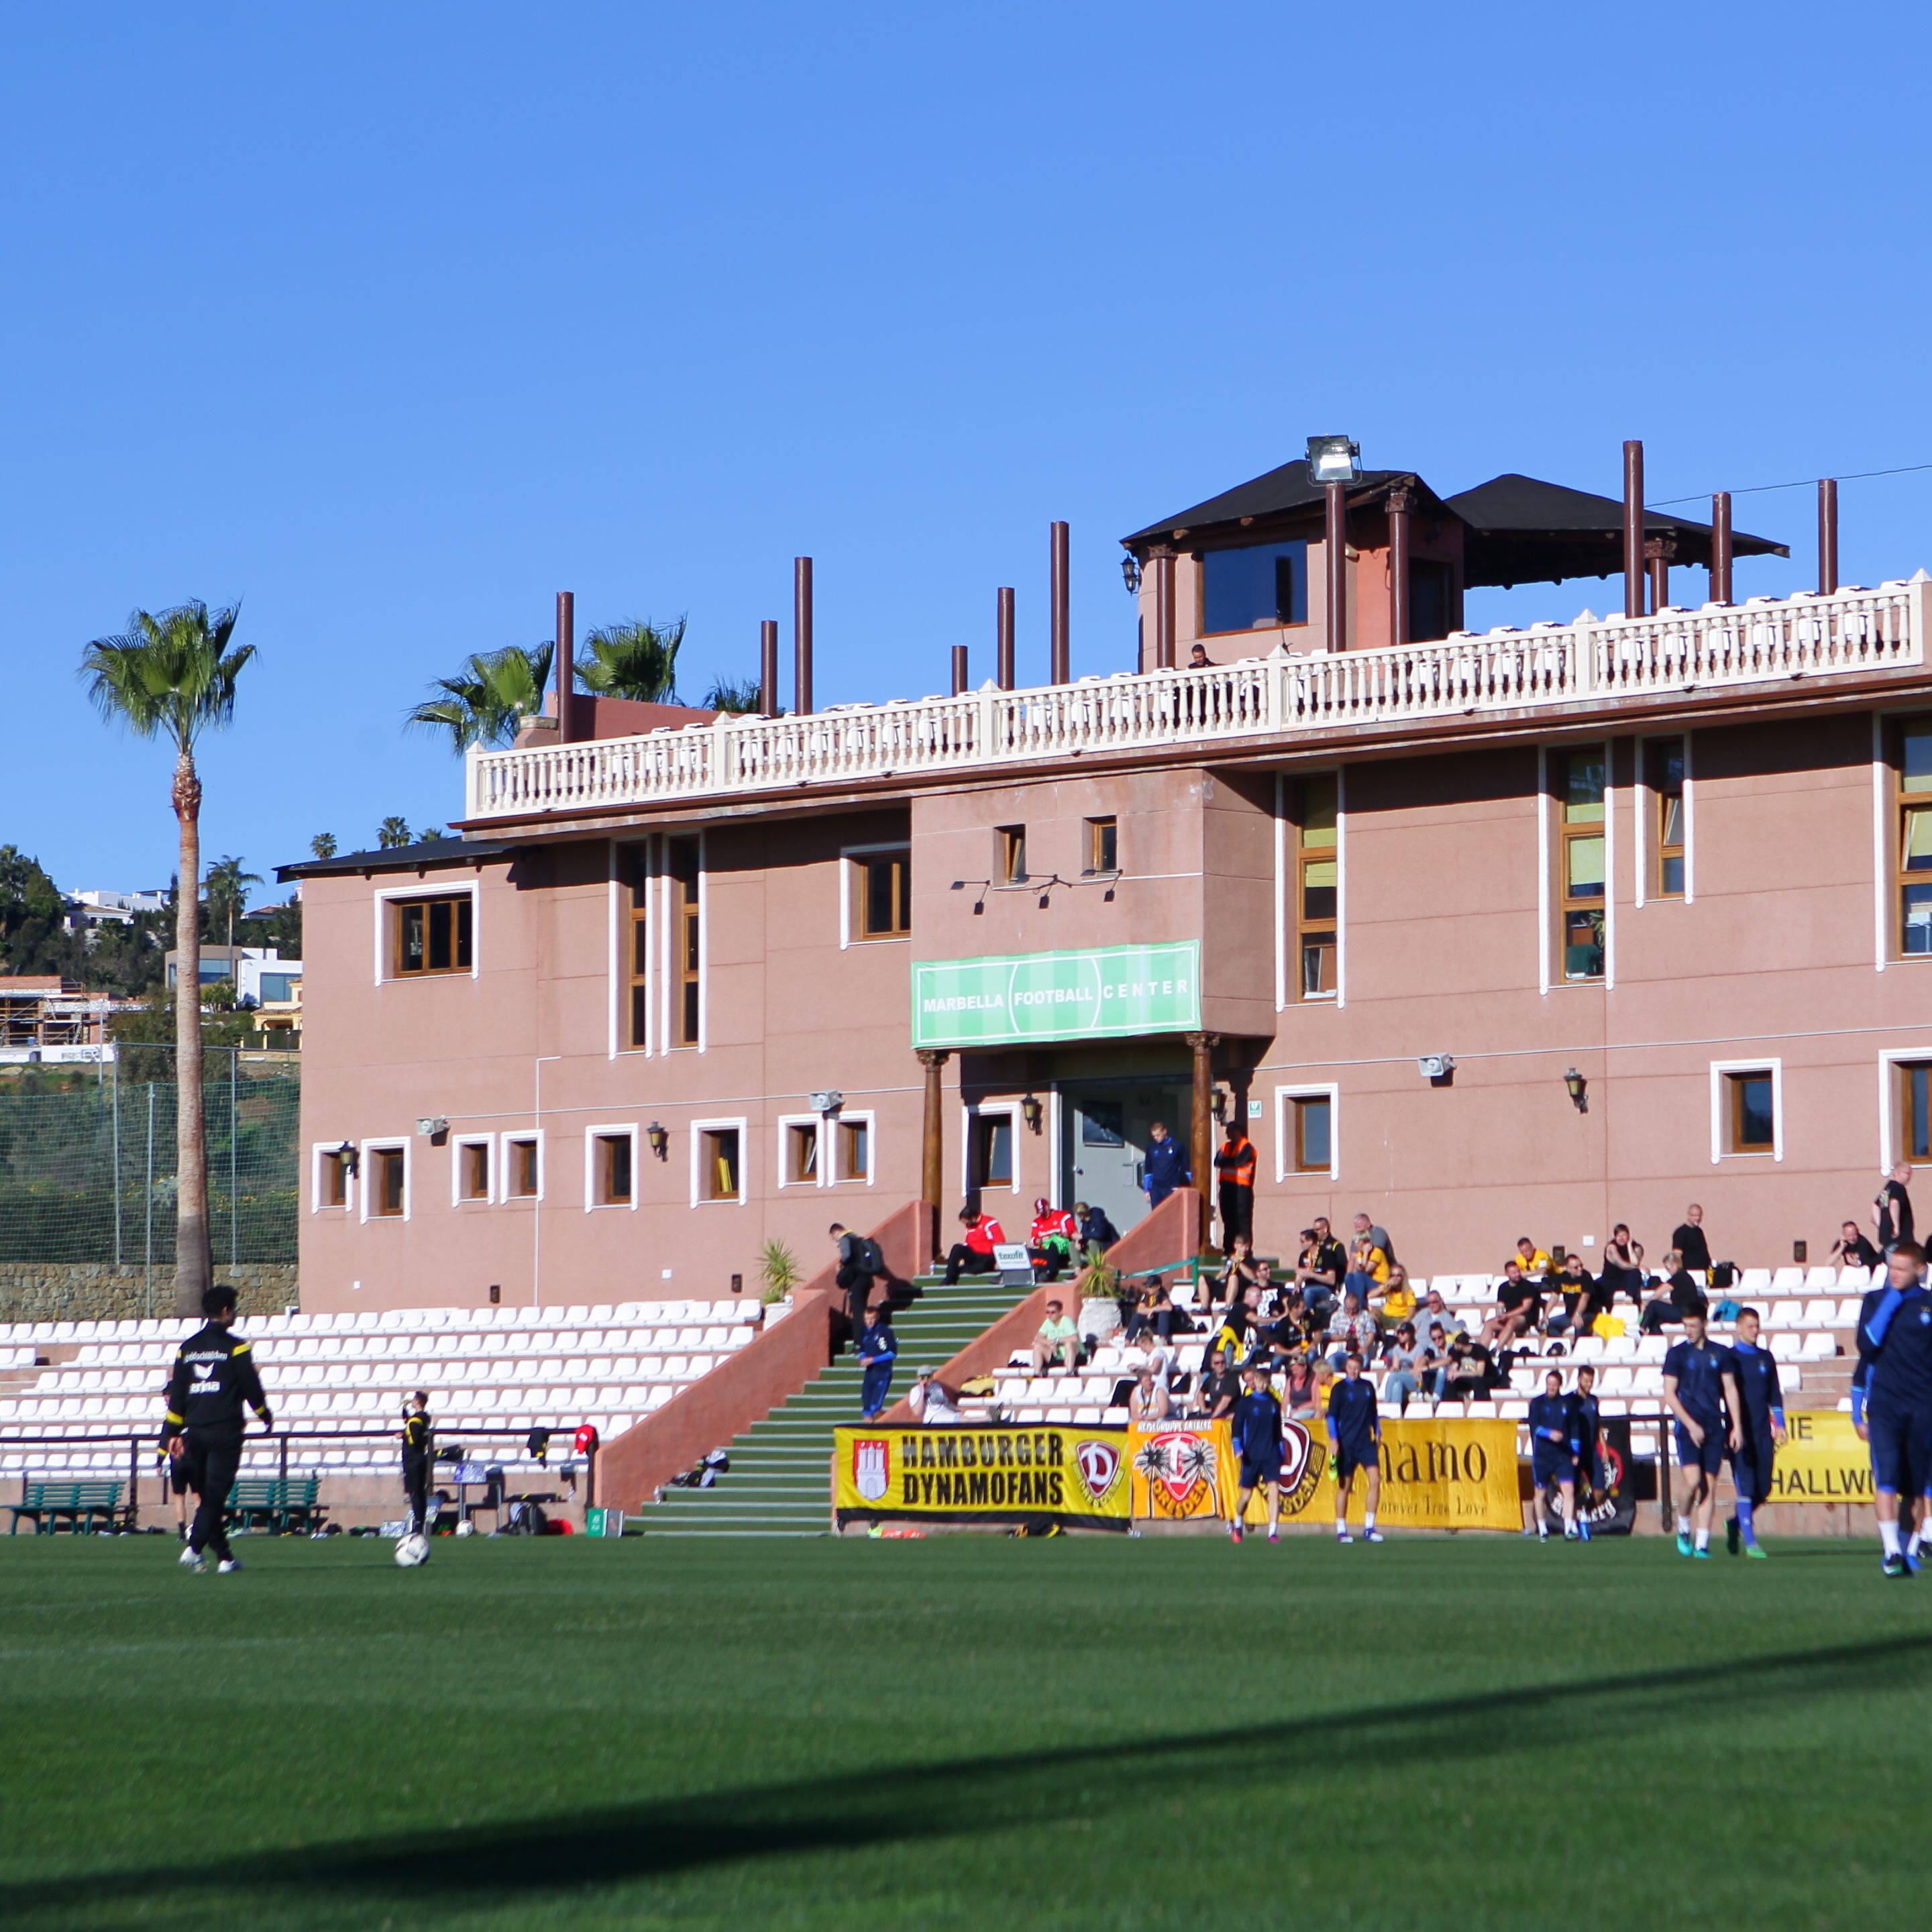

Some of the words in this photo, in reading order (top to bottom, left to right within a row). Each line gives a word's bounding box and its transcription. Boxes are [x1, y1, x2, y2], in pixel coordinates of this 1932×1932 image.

[924, 994, 1004, 1012] MARBELLA
[1014, 988, 1094, 1006] FOOTBALL
[1103, 979, 1187, 1000] CENTER
[902, 1434, 1063, 1467] HAMBURGER
[902, 1472, 1064, 1505] DYNAMOFANS
[1153, 1477, 1208, 1519] DRESDEN
[1456, 1495, 1487, 1515] Love
